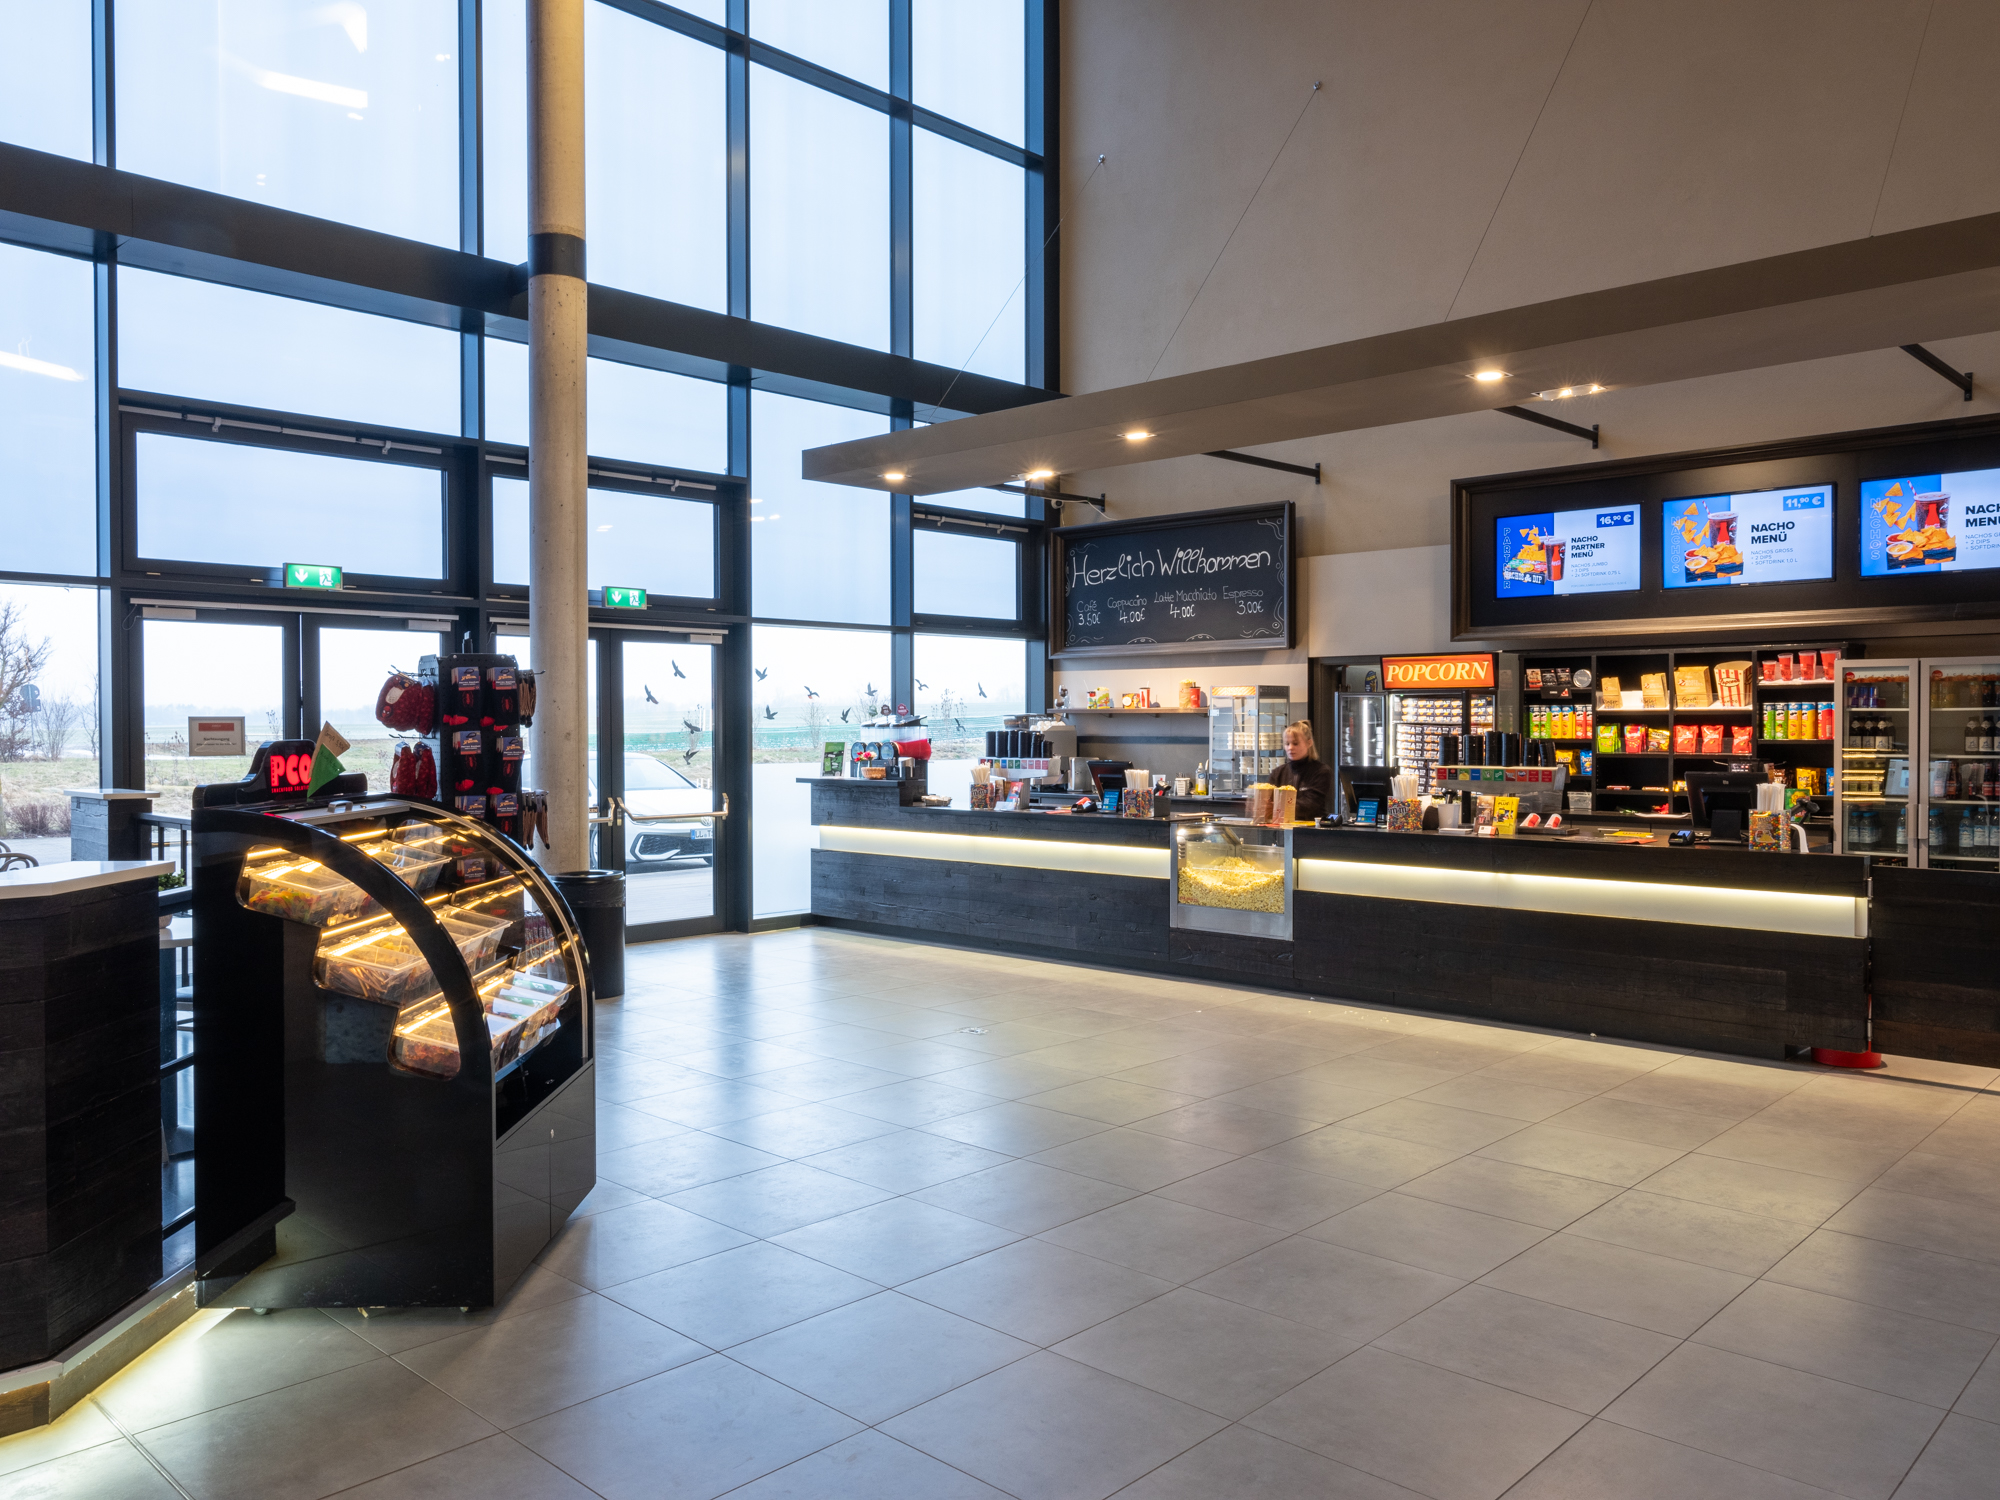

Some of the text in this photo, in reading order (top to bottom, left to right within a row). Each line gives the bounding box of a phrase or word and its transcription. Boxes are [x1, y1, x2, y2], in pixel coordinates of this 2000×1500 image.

[1785, 496, 1822, 508] 11,90 €
[1599, 514, 1632, 526] 16,90 €
[1750, 521, 1796, 533] NACHO
[1965, 516, 2000, 528] MEN
[1570, 535, 1599, 543] NACHO
[1750, 531, 1788, 545] MENÜ
[1570, 543, 1606, 551] PARTNER
[1570, 550, 1594, 559] MENÜ
[1072, 547, 1271, 588] Herzlich Willkommen
[1153, 587, 1217, 603] Latte Macchiato
[1222, 586, 1264, 604] Espresso
[1076, 600, 1097, 612] Café
[1169, 603, 1196, 618] 4.00€
[1236, 600, 1264, 615] 3.00€
[1078, 611, 1101, 626] 3.50€
[1119, 607, 1146, 623] 4.00€
[1386, 661, 1490, 683] POPCORN
[270, 753, 312, 787] PCO
